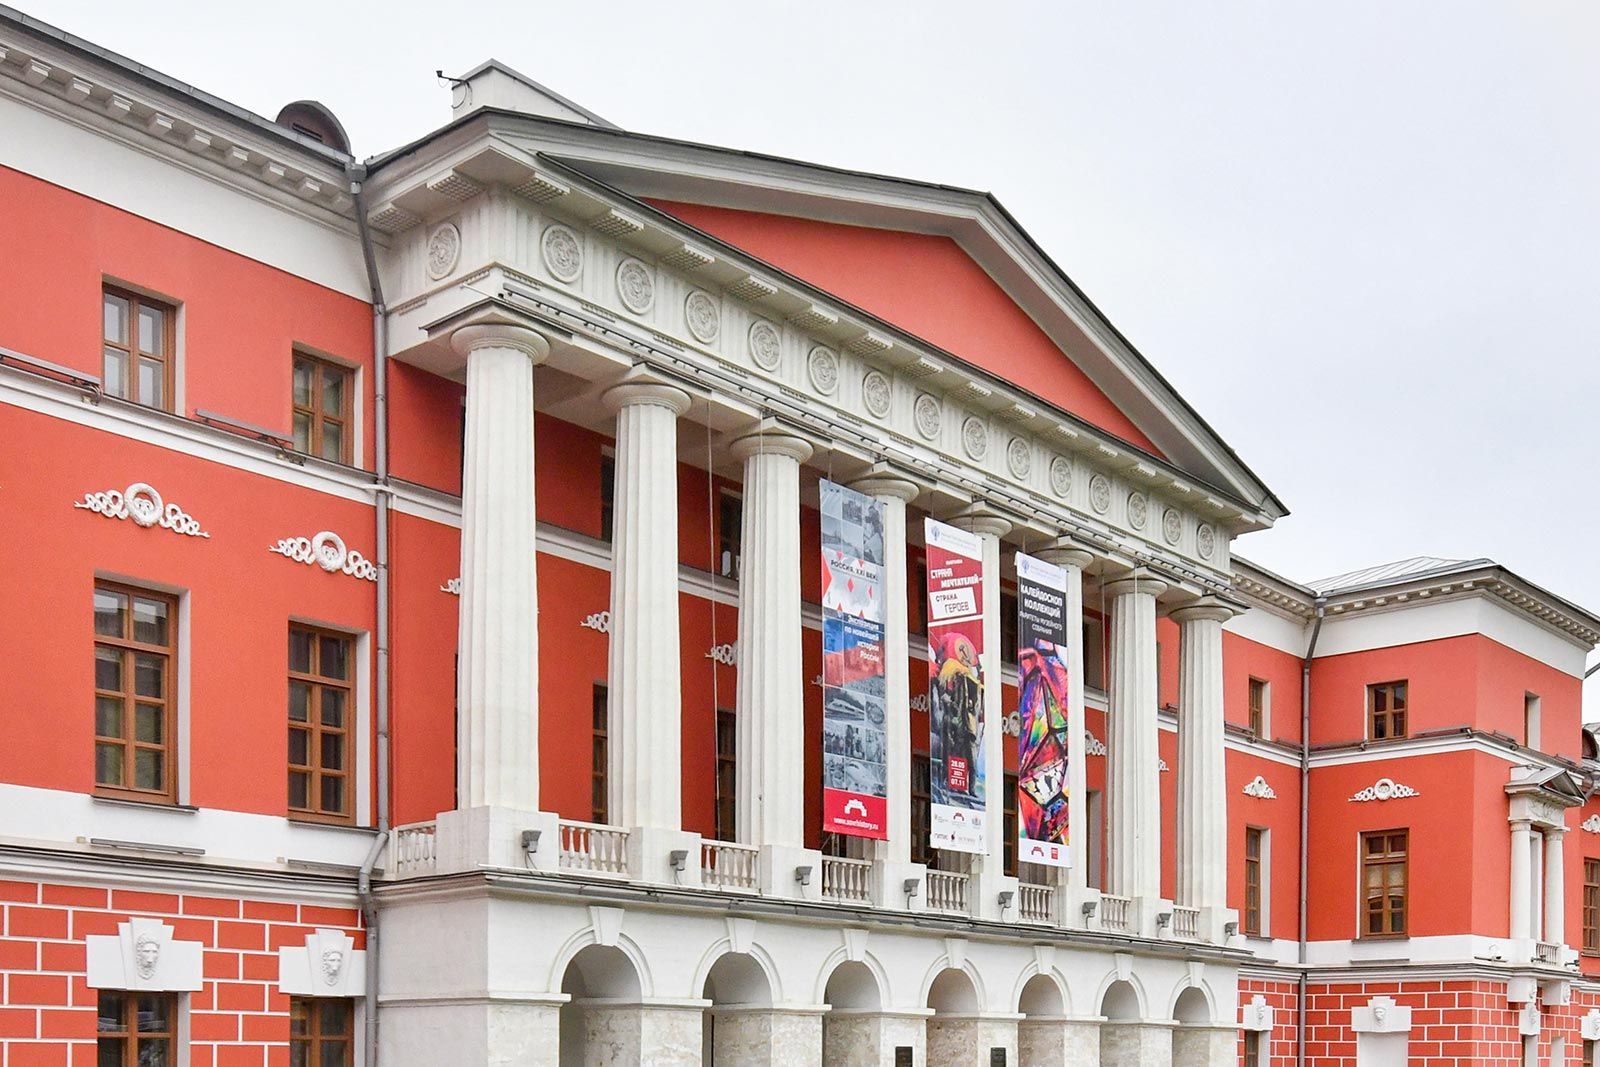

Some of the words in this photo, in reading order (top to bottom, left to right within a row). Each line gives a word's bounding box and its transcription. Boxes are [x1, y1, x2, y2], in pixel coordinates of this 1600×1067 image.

[930, 567, 953, 579] СТРАНА
[935, 594, 958, 602] СТРАНА
[1020, 583, 1062, 607] КАЛЕЙДОСКОП
[944, 601, 970, 614] ГЕРОЕВ
[1024, 598, 1061, 619] КОЛЛЕКЦИЙ
